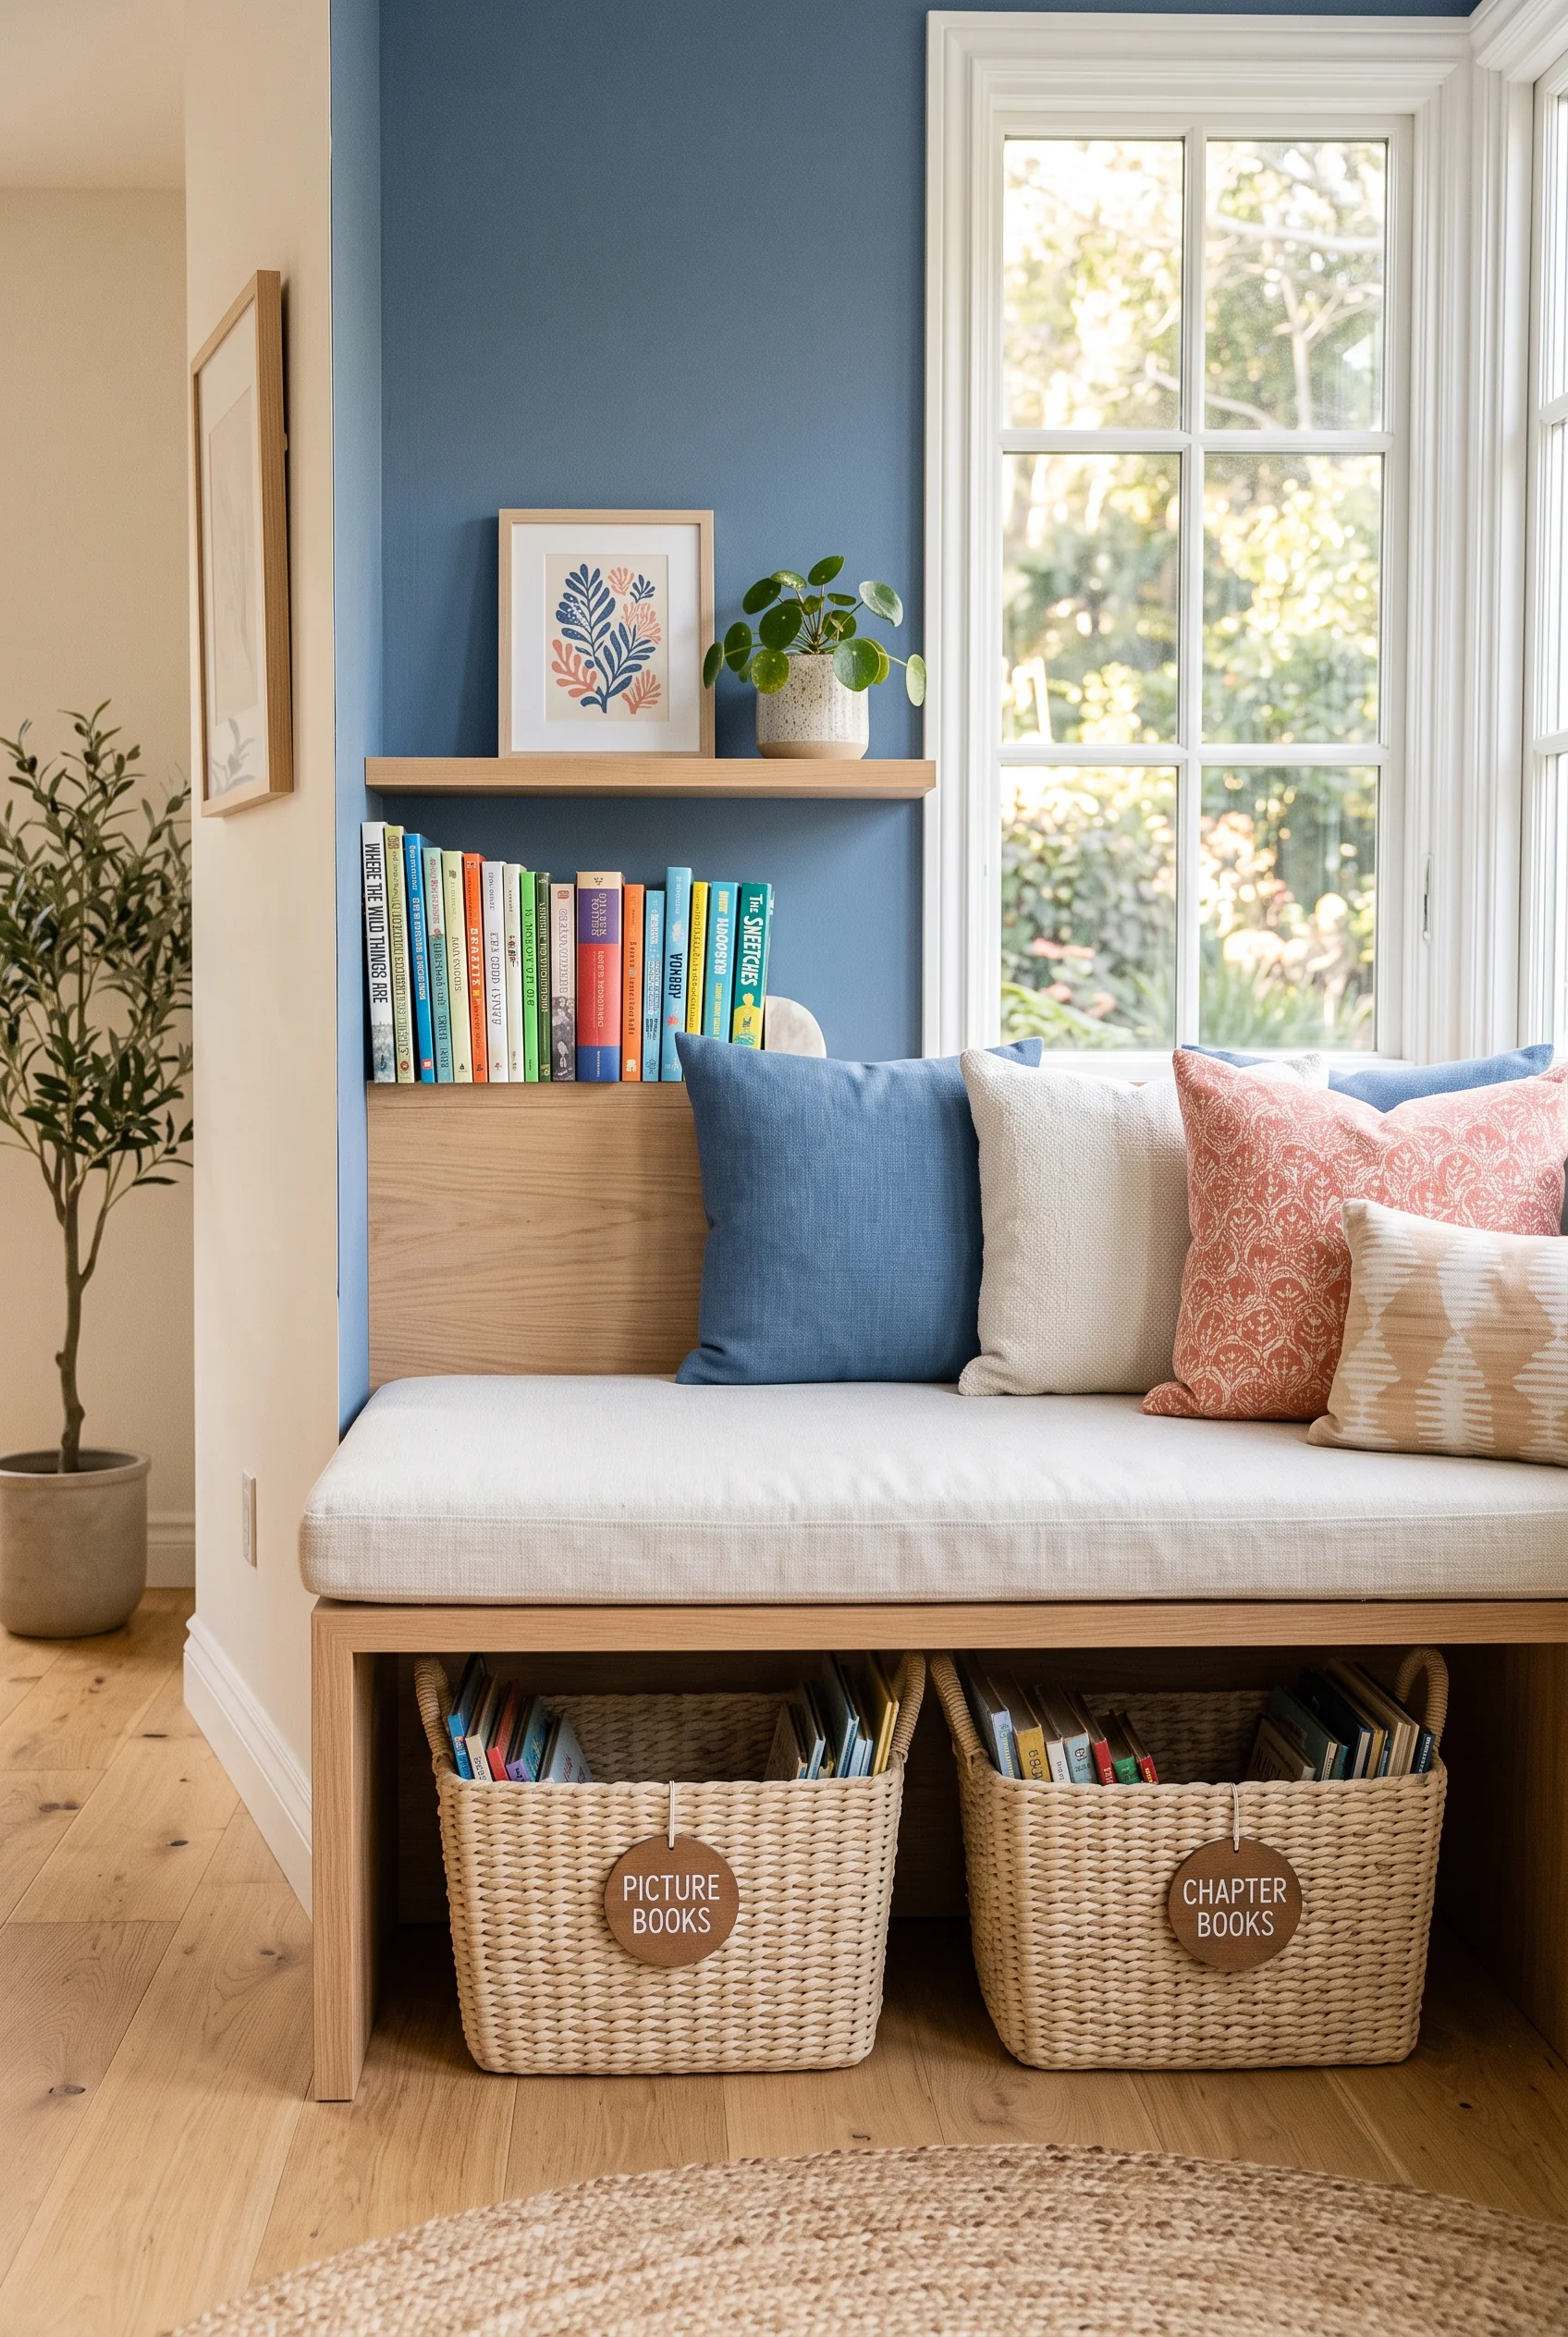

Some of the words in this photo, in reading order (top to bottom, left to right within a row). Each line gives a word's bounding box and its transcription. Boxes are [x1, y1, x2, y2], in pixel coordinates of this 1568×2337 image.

[365, 843, 382, 879] WHERE
[367, 883, 383, 901] THE
[368, 906, 384, 932] WILD
[370, 936, 386, 978] THINGS
[741, 915, 764, 986] SNEETCHES
[373, 983, 387, 1003] ARE
[623, 1875, 720, 1901] PICTURE
[1183, 1878, 1287, 1904] CHAPTER
[633, 1907, 711, 1934] BOOKS
[1197, 1911, 1274, 1938] BOOKS
